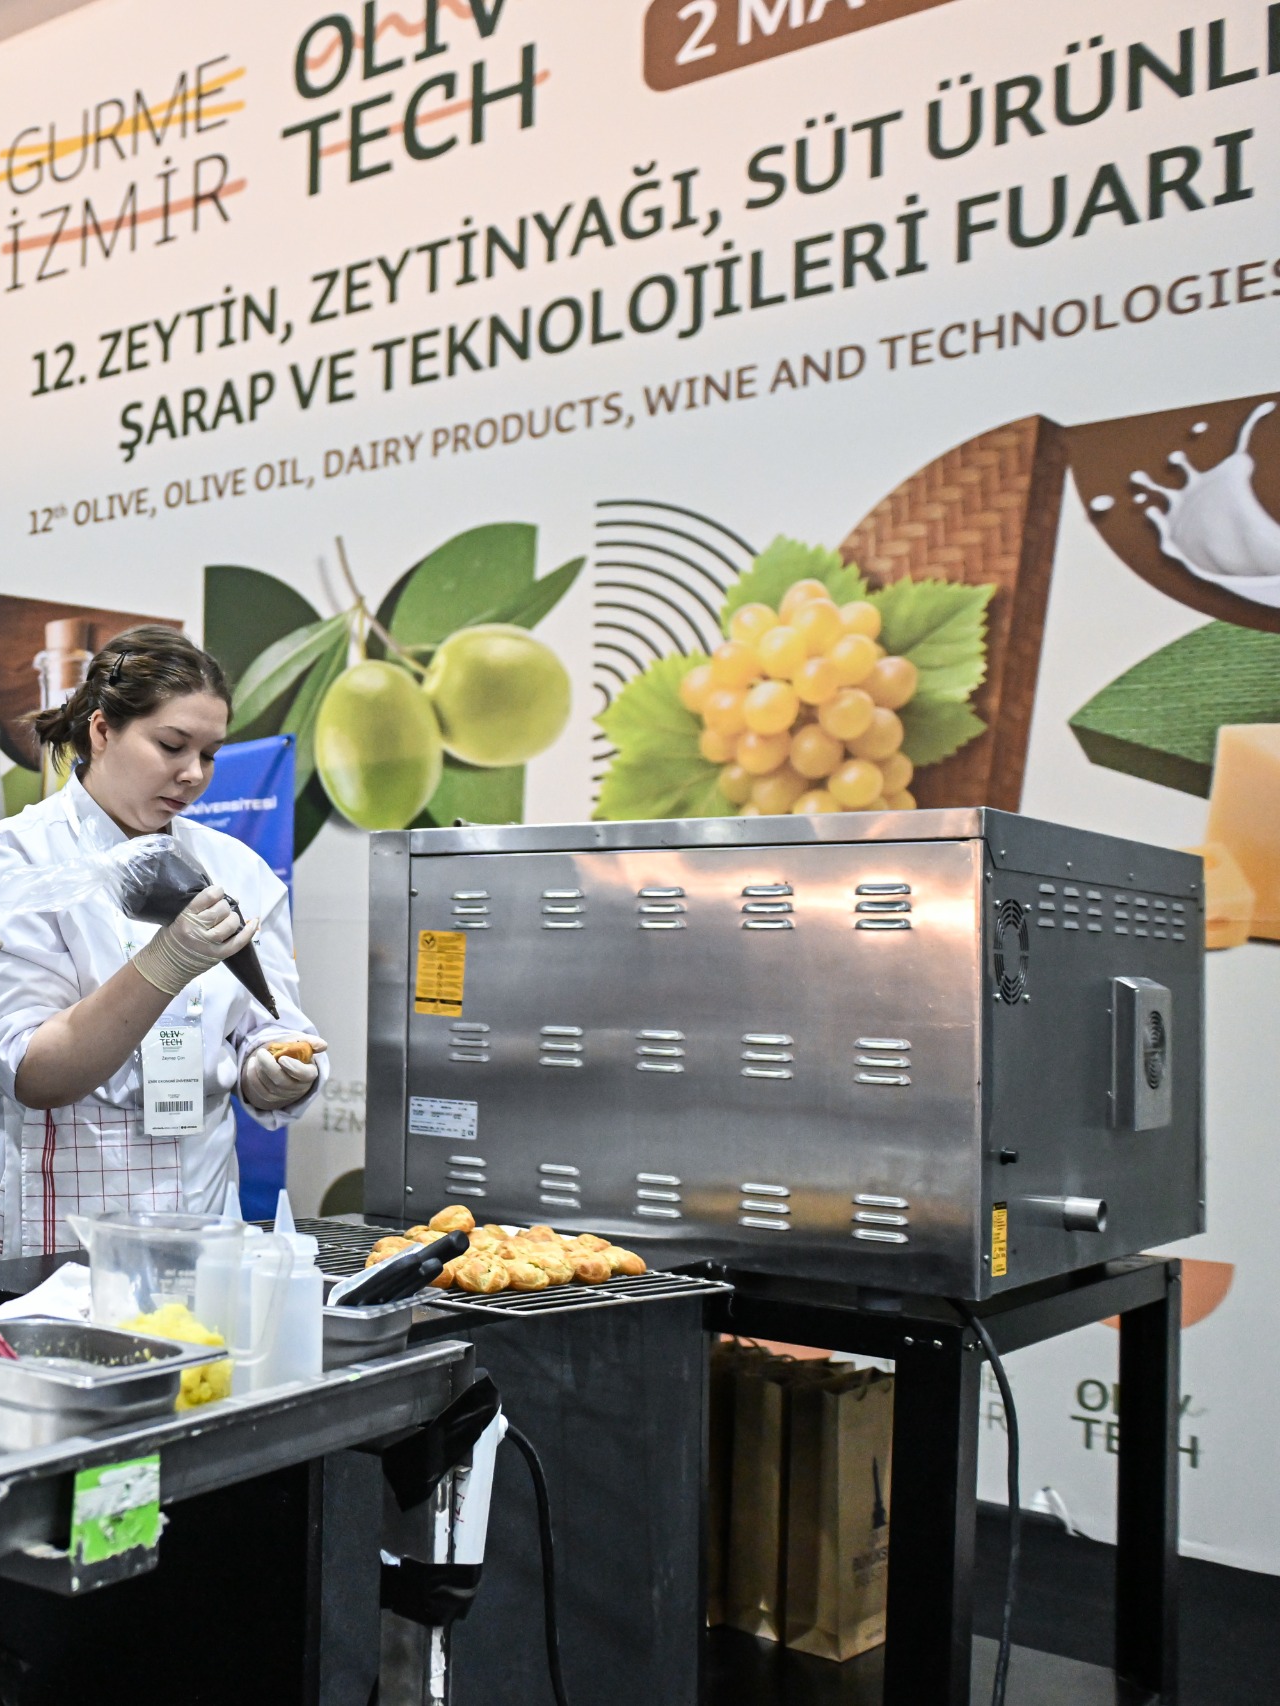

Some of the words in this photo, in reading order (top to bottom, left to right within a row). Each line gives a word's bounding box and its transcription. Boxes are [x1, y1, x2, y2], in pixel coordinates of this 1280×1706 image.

[675, 0, 717, 65] 2
[6, 54, 231, 196] GURME
[281, 42, 536, 196] TECH
[5, 154, 231, 293] İZMİR
[31, 342, 87, 397] 12.
[98, 285, 293, 381] ZEYTİN,
[311, 161, 721, 324] ZEYTİNYAĞI,
[746, 111, 904, 211] SÜT
[927, 2, 1280, 161] ÜRÜNL
[117, 371, 276, 462] ŞARAP
[290, 350, 357, 411] VE
[373, 194, 928, 391] TEKNOLOJİLERİ
[954, 128, 1255, 264] FUARI
[73, 487, 157, 526] OLIVE,
[164, 467, 247, 509] OLIVE
[254, 456, 316, 493] OIL,
[323, 432, 426, 479] DAIRY
[432, 392, 636, 458] PRODUCTS,
[643, 365, 759, 415] WINE
[769, 344, 867, 394] AND
[879, 258, 1280, 371] TECHNOLOGIE
[159, 1038, 183, 1046] TECH
